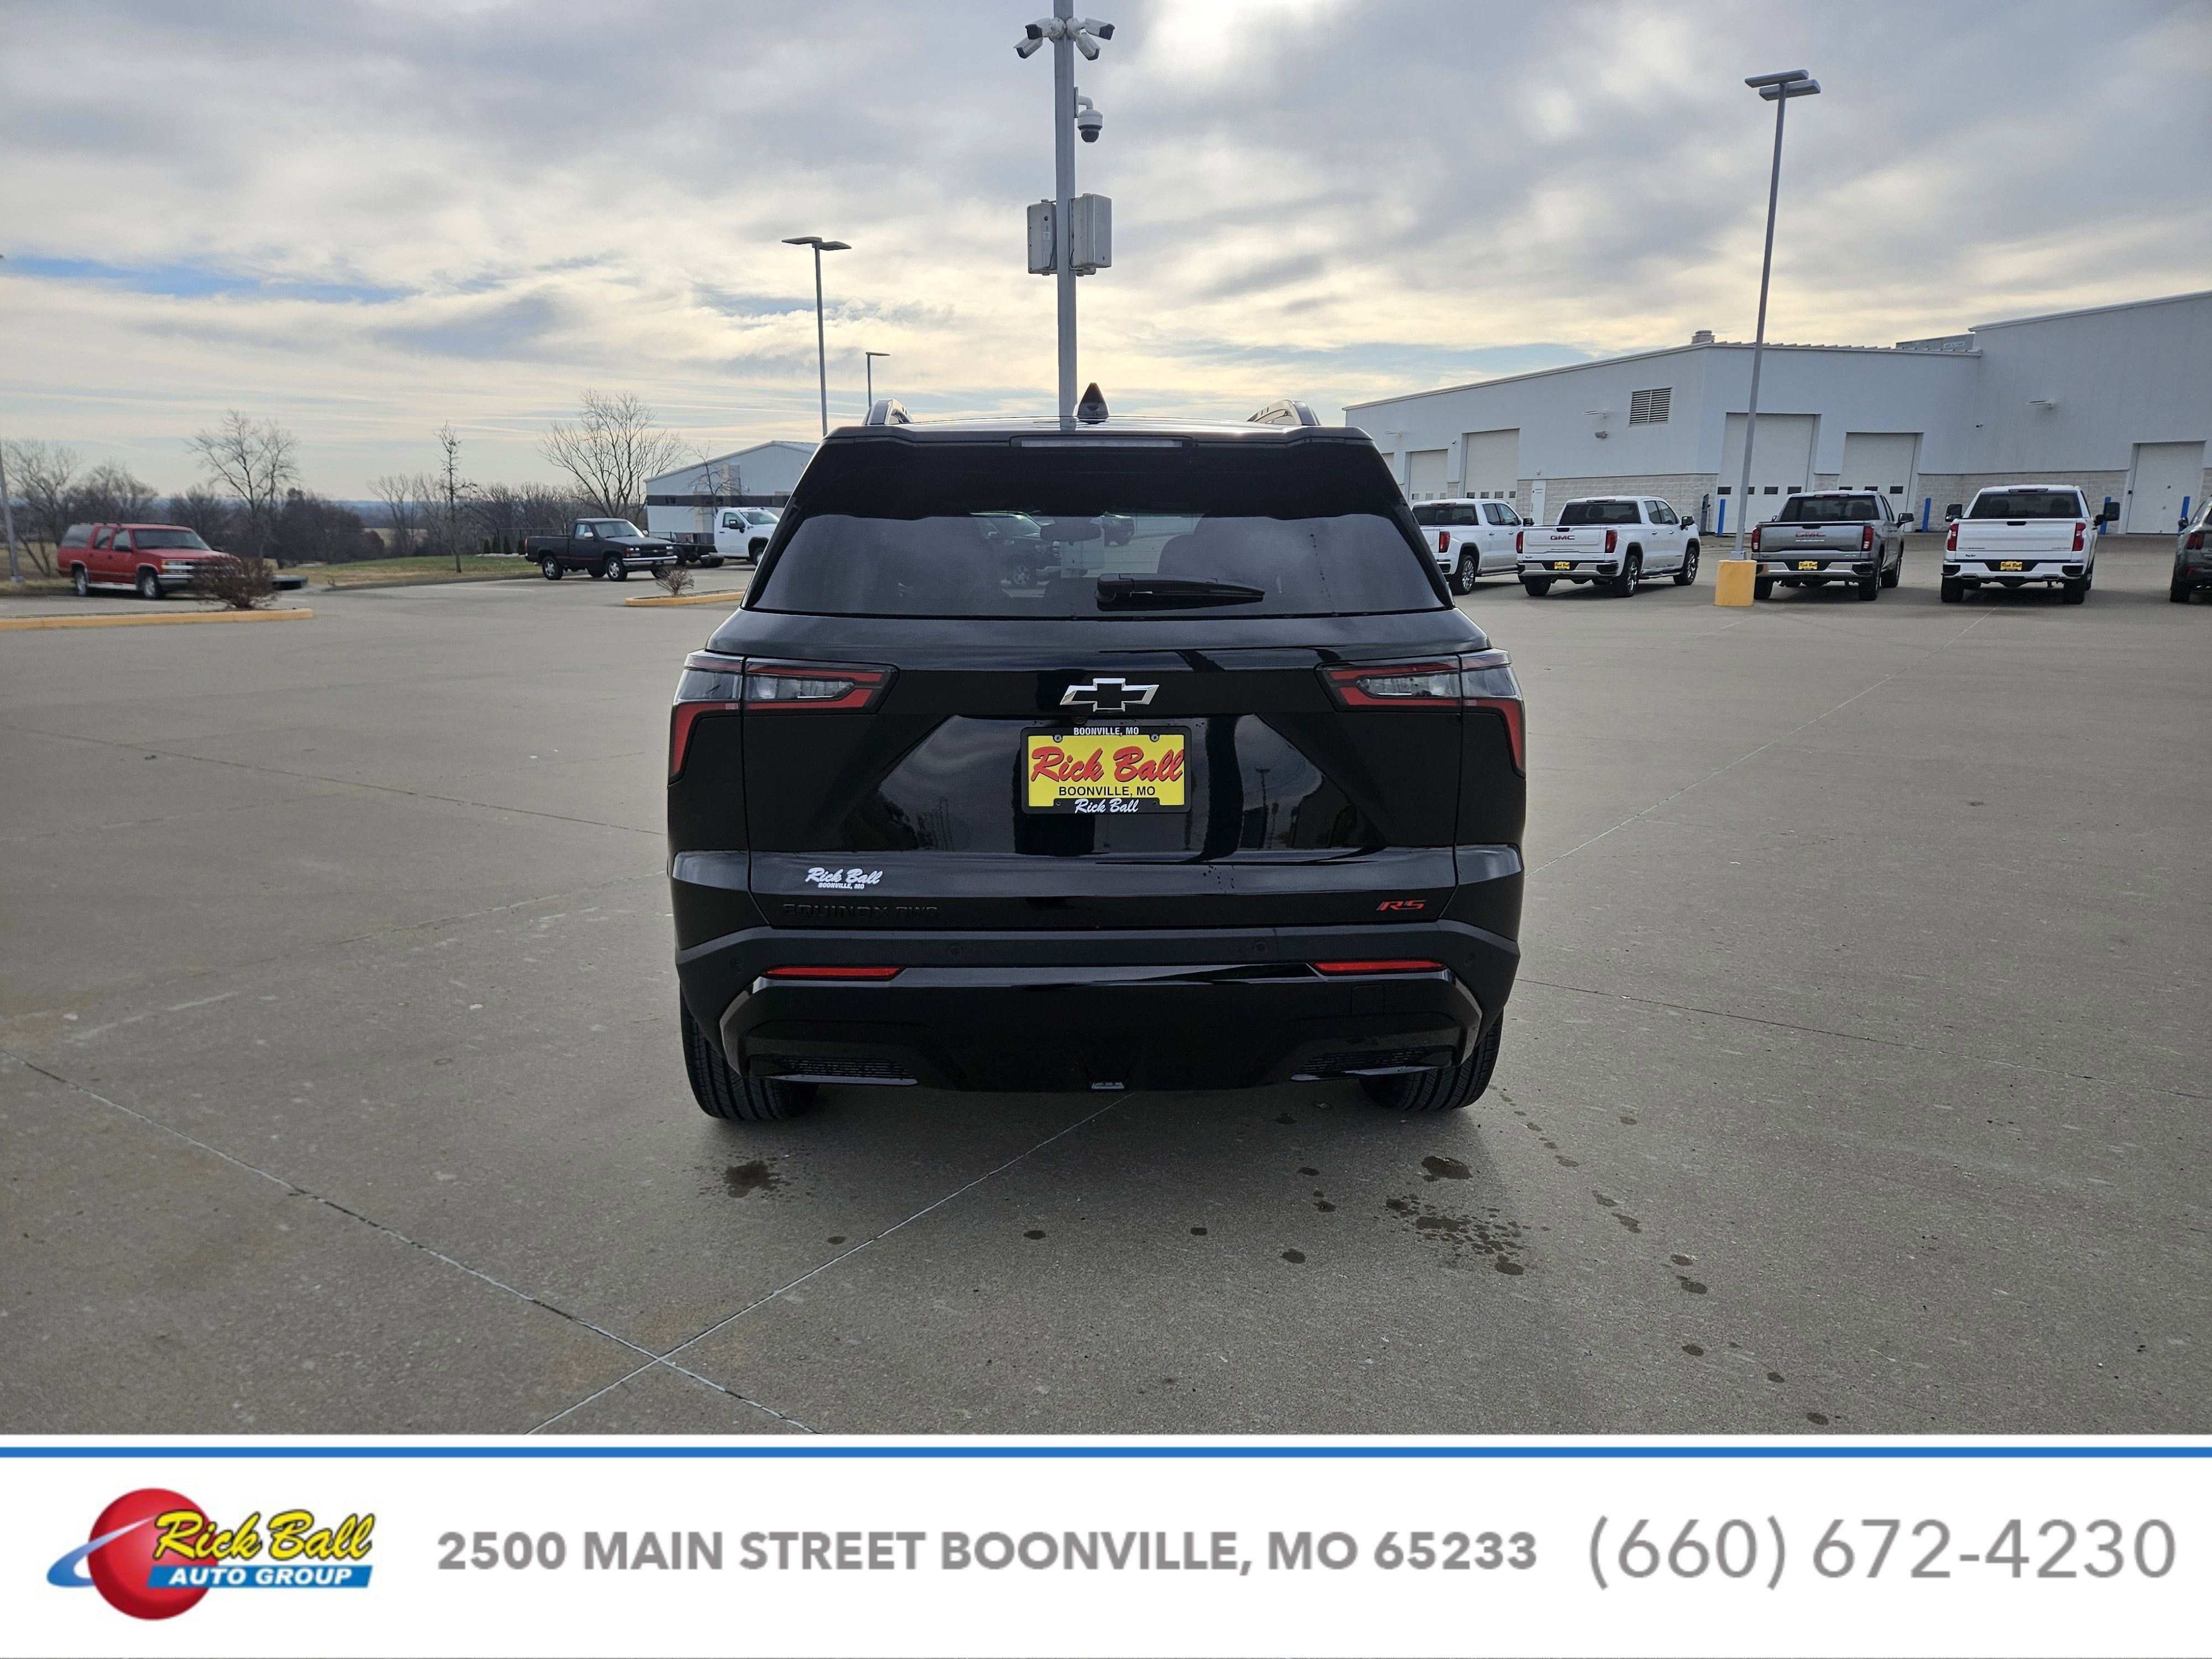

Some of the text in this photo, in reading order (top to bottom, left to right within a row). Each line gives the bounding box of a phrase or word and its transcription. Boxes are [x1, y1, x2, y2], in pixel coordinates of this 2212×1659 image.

[1073, 727, 1123, 736] BOONVILLE,
[1030, 745, 1185, 782] Rick Ball
[1058, 786, 1155, 797] BOONVILLE, MO
[1074, 797, 1139, 813] Rick Ball
[805, 867, 883, 884] Rick Ball
[783, 904, 889, 917] EQUINOX
[1376, 900, 1426, 911] RS
